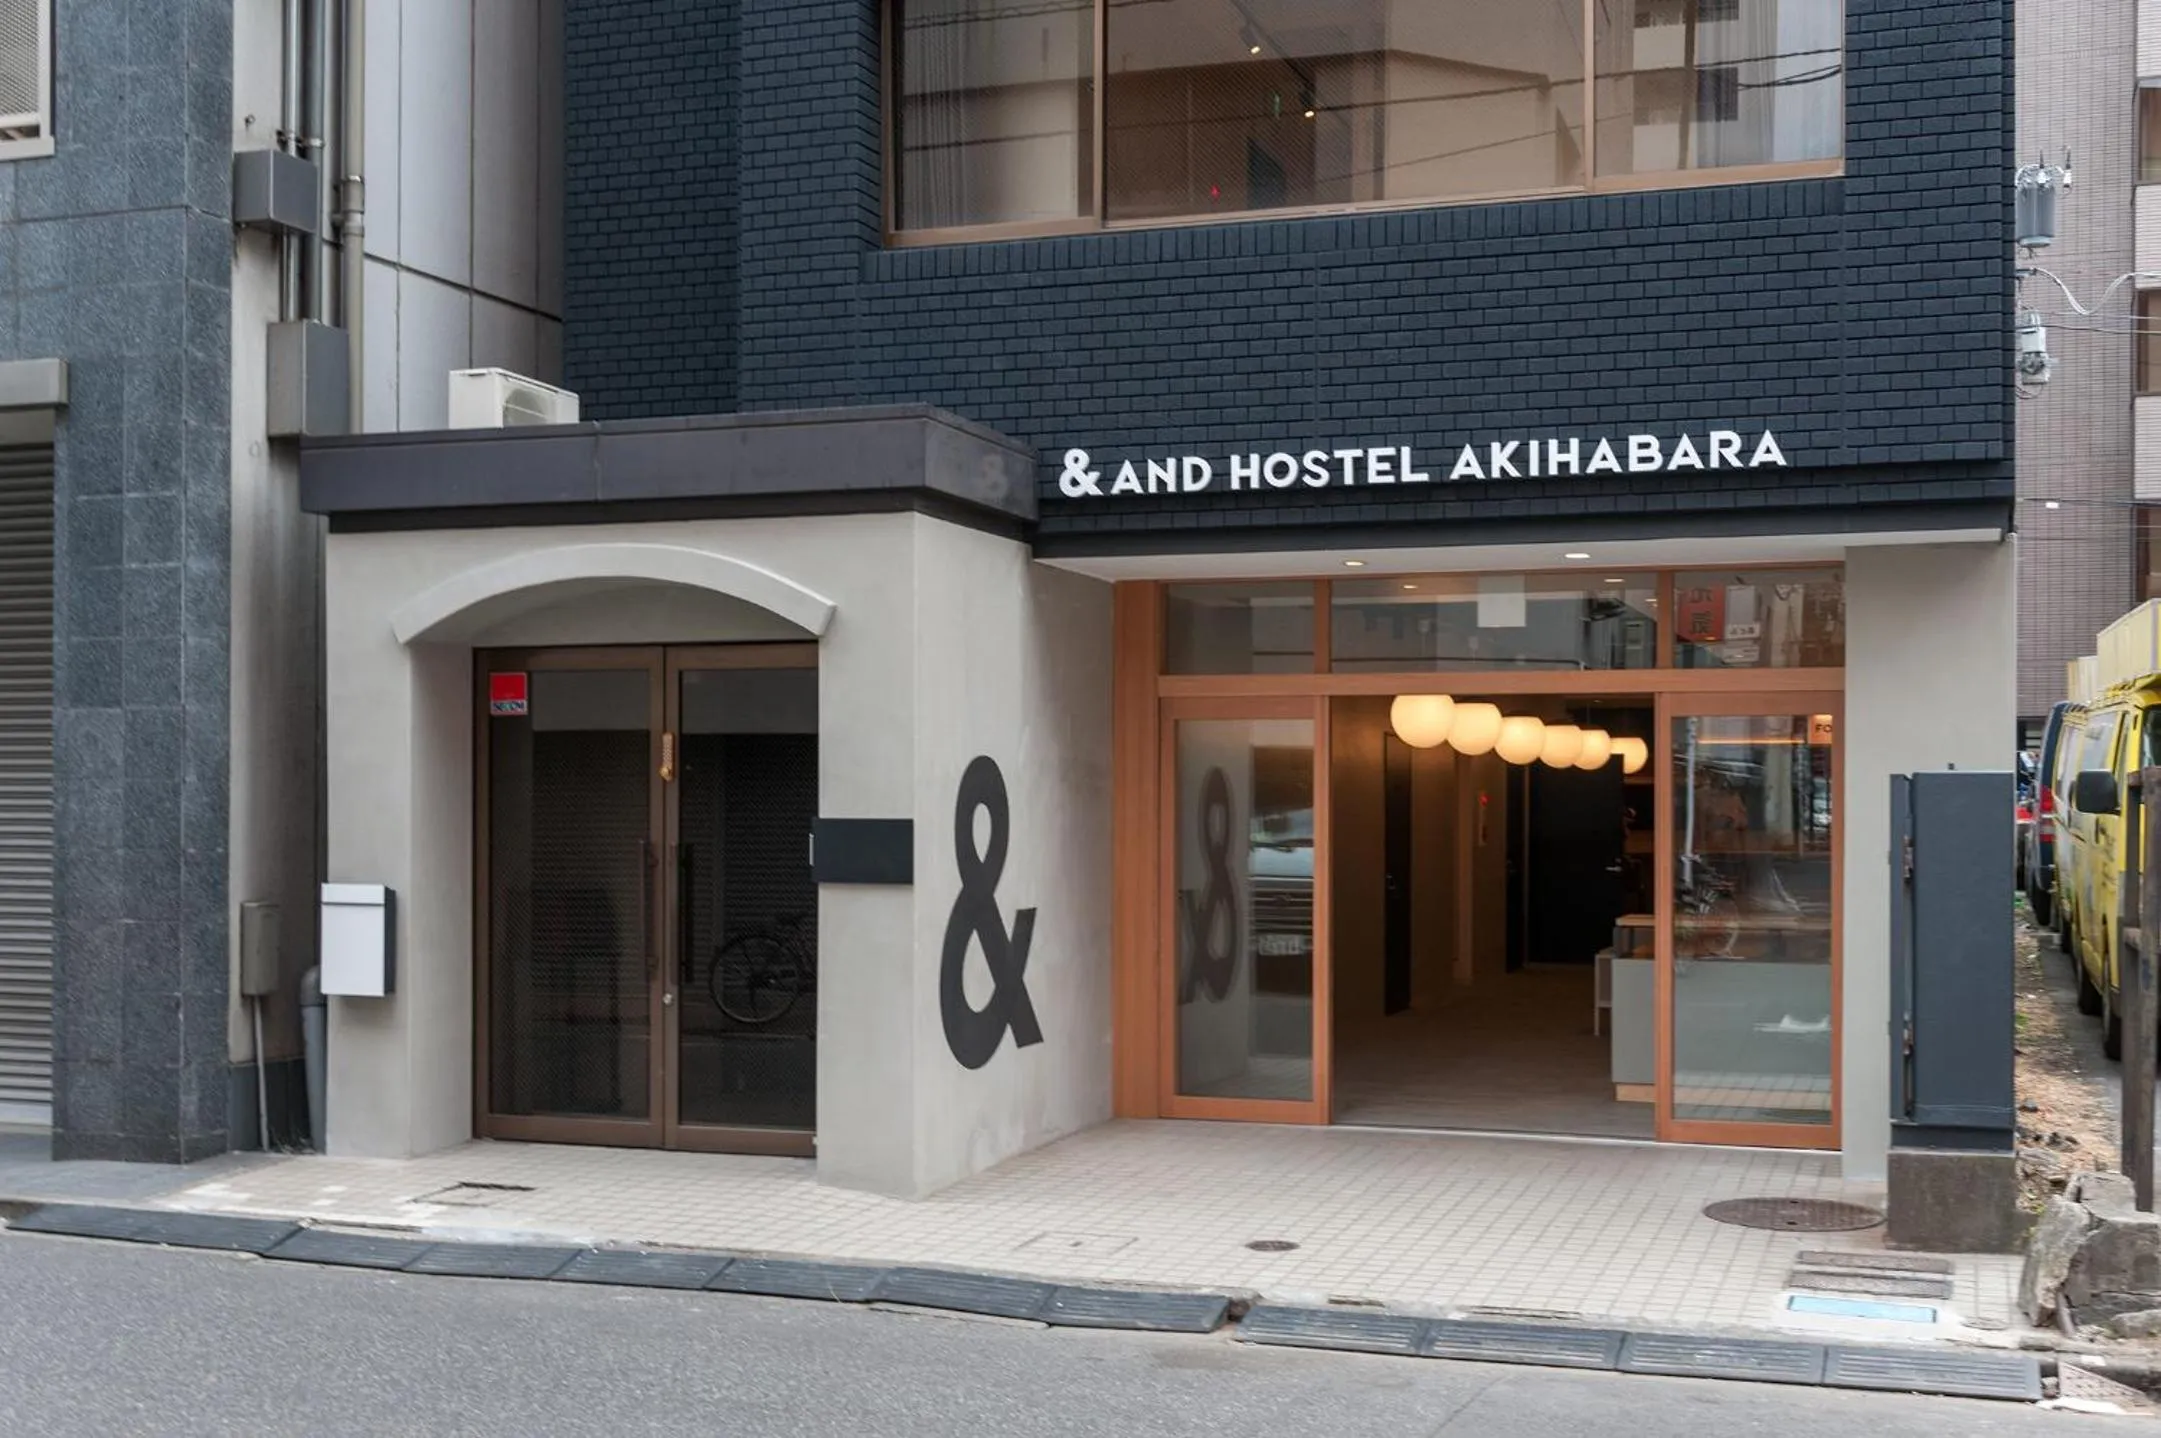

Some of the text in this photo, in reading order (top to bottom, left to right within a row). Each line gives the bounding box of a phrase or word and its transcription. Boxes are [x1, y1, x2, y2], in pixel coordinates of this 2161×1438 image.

[1058, 430, 1788, 498] & AND HOSTEL AKIHABARA
[939, 755, 1044, 1070] &
